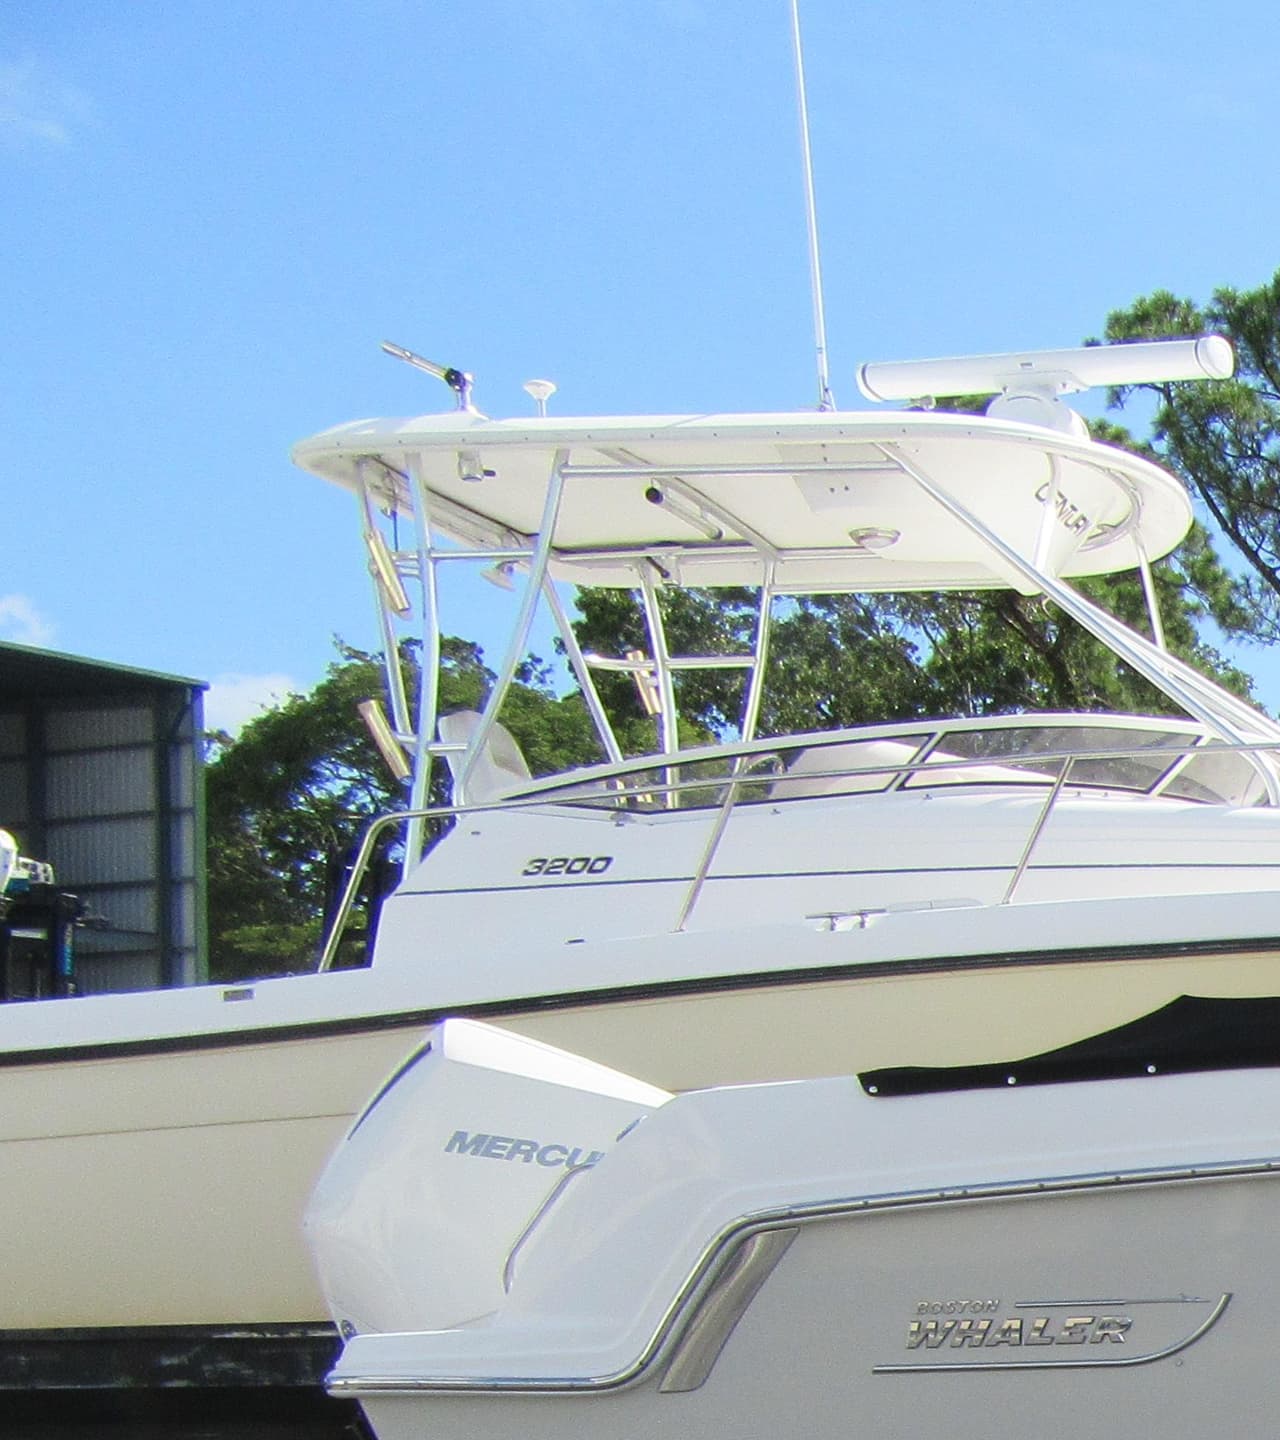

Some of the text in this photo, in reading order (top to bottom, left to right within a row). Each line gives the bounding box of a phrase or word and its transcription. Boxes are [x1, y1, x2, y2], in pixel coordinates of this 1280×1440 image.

[522, 856, 614, 876] 3200
[444, 1130, 605, 1169] MERCU
[916, 1300, 1000, 1315] BOSTON
[906, 1316, 1134, 1349] WHALER
